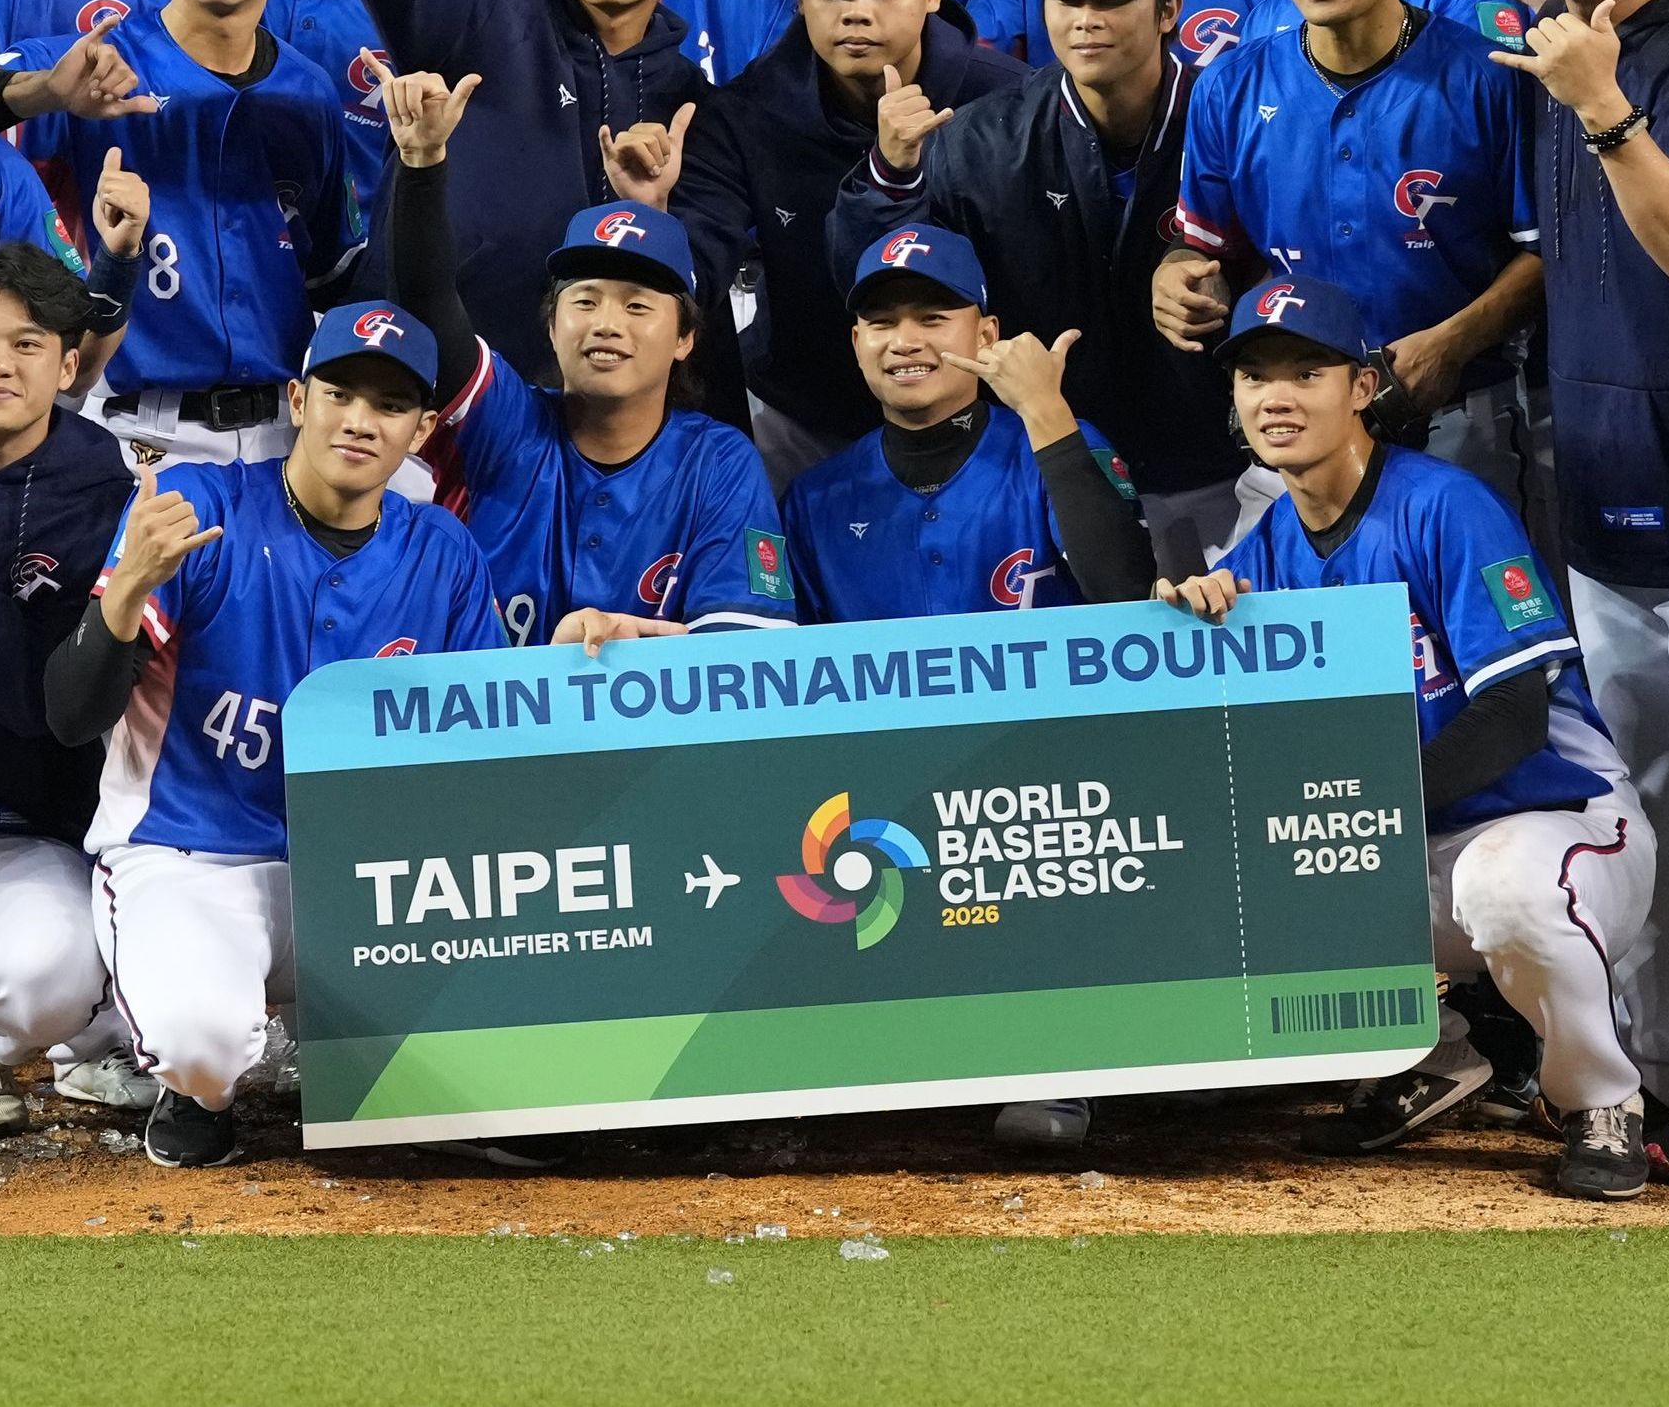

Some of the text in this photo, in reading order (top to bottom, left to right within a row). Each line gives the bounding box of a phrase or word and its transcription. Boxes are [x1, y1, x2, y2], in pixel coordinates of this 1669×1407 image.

[343, 109, 384, 129] Taipei
[1522, 608, 1542, 619] CTBC
[373, 620, 1326, 737] MAIN TOURNAMENT BOUND!
[1422, 678, 1459, 702] Taipei
[202, 690, 278, 770] 45
[933, 781, 1111, 826] WORLD
[1303, 779, 1361, 800] DATE
[937, 815, 1184, 866] BASEBALL
[1267, 809, 1403, 843] MARCH
[1293, 844, 1381, 876] 2026
[355, 844, 634, 926] TAIPEI
[942, 905, 1000, 926] 2026
[353, 926, 653, 967] POOL QUALIFIER TEAM
